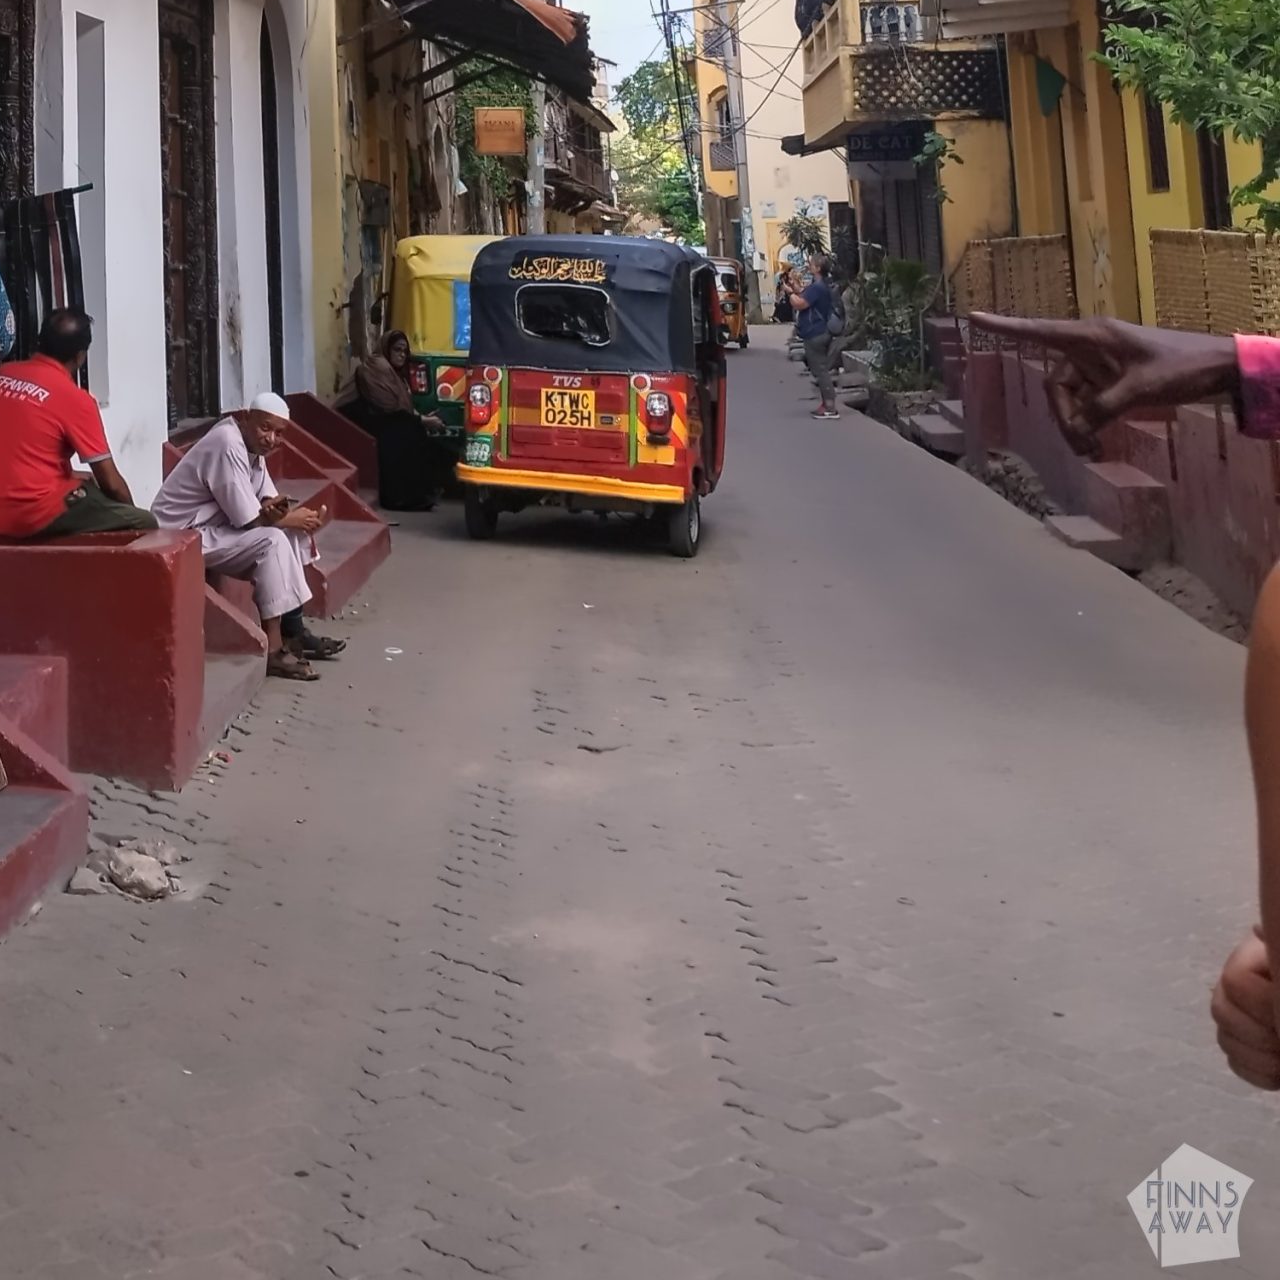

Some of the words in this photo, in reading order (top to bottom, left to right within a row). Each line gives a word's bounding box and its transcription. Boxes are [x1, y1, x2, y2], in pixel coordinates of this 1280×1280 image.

[850, 135, 872, 150] DE
[552, 375, 582, 388] TVS
[545, 391, 590, 409] KTWC
[545, 408, 591, 426] 025H
